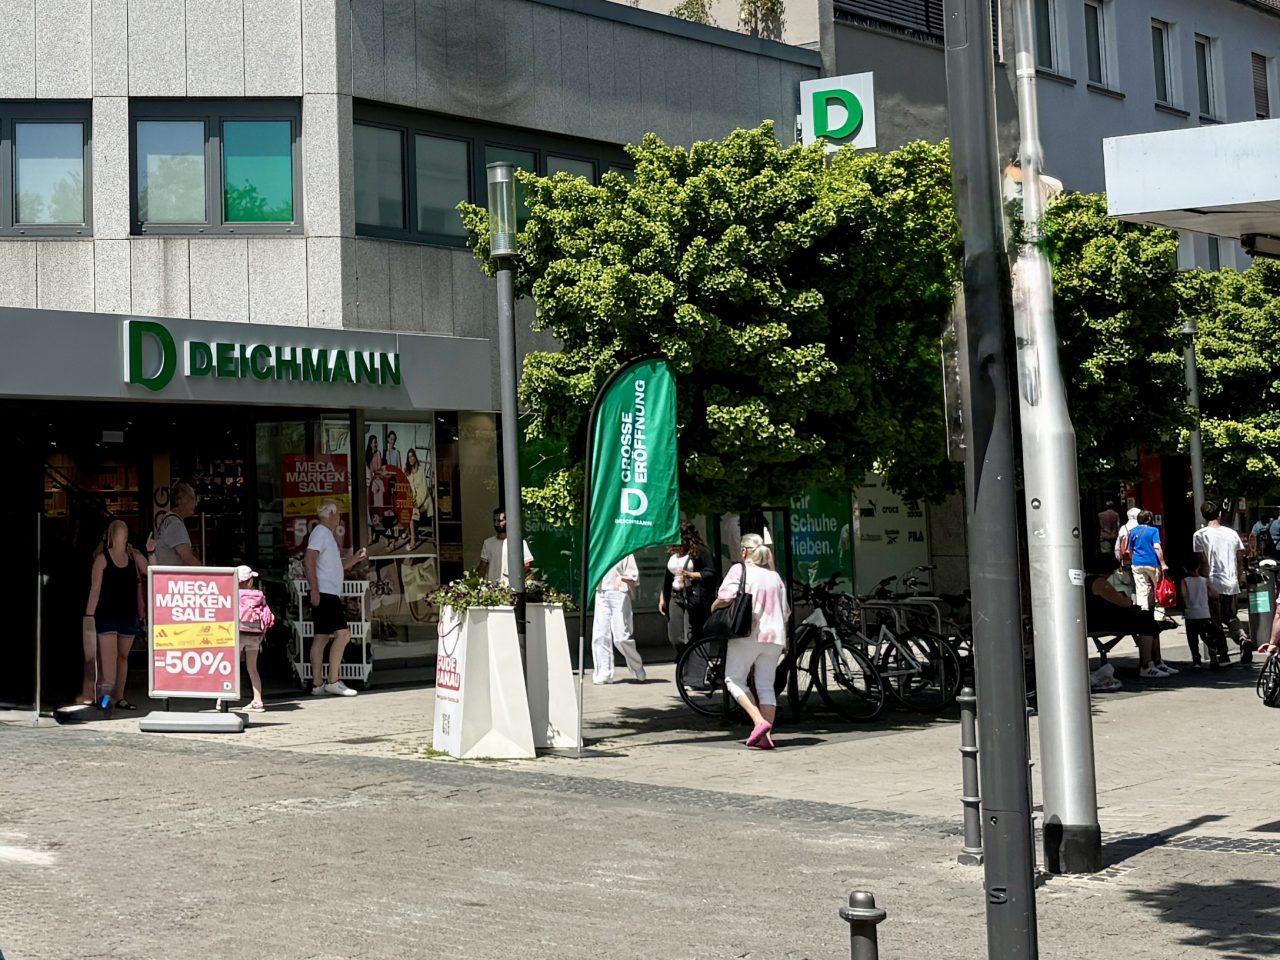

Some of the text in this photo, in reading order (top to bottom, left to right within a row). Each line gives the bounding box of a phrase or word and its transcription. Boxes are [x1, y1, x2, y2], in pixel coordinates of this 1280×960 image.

[813, 88, 863, 139] D
[123, 320, 401, 391] D DEICHMANN
[632, 379, 648, 484] ERÖFFNUNG
[621, 411, 633, 483] GROSSE
[295, 461, 335, 472] MEGA
[286, 472, 345, 482] MARKEN
[299, 483, 333, 493] SALE
[620, 487, 649, 517] D
[791, 514, 837, 532] Schuhe
[908, 530, 924, 542] FILA
[791, 536, 833, 555] lieben.
[168, 580, 219, 595] MEGA
[155, 593, 232, 608] MARKEN
[171, 607, 216, 621] SALE
